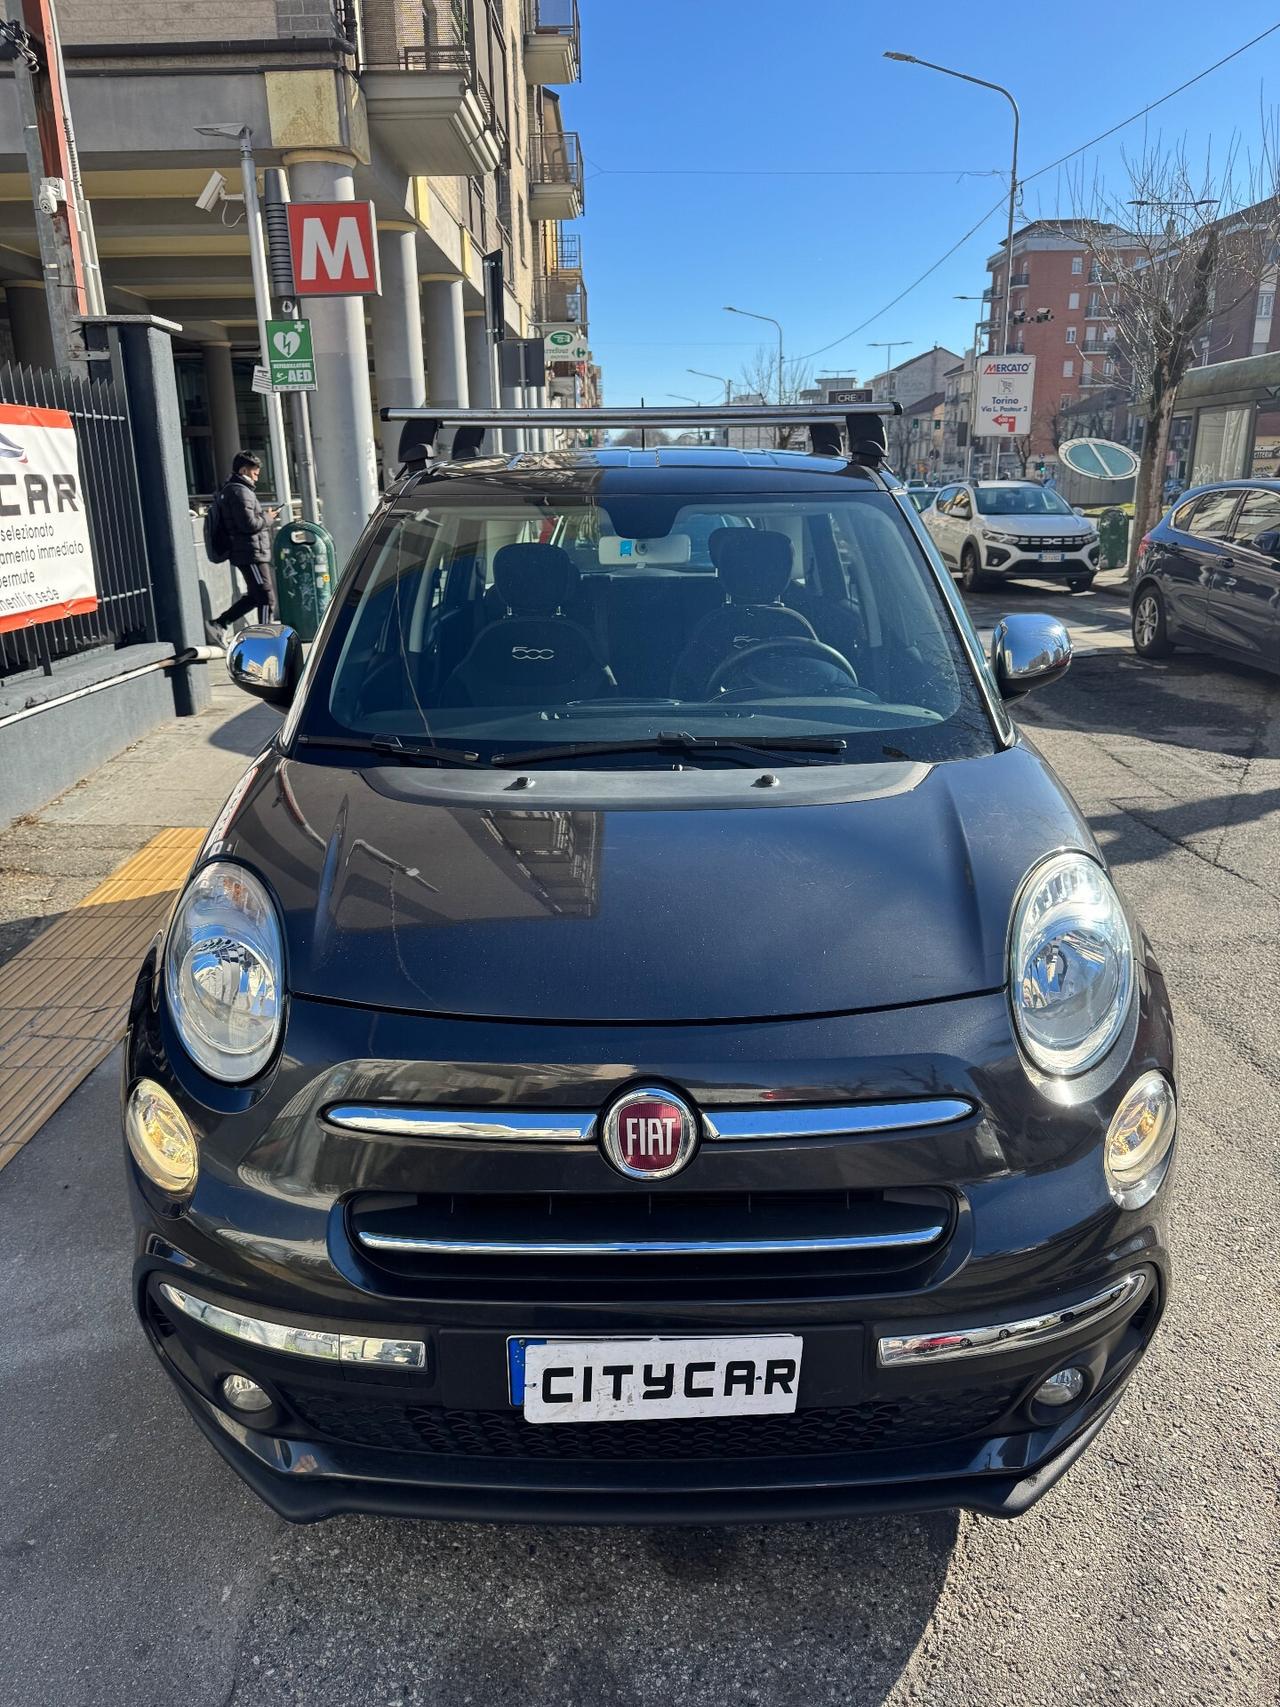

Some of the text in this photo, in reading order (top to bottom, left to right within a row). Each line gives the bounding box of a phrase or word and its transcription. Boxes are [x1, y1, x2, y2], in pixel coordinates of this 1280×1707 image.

[301, 217, 370, 281] M
[288, 370, 313, 383] AED
[992, 396, 1019, 405] Torino
[0, 522, 54, 542] selezionato
[37, 540, 84, 560] immediato
[23, 591, 37, 606] in
[35, 586, 60, 603] sede
[512, 646, 555, 660] 500
[626, 1117, 677, 1156] FIAT
[542, 1359, 797, 1403] CITYCAR
